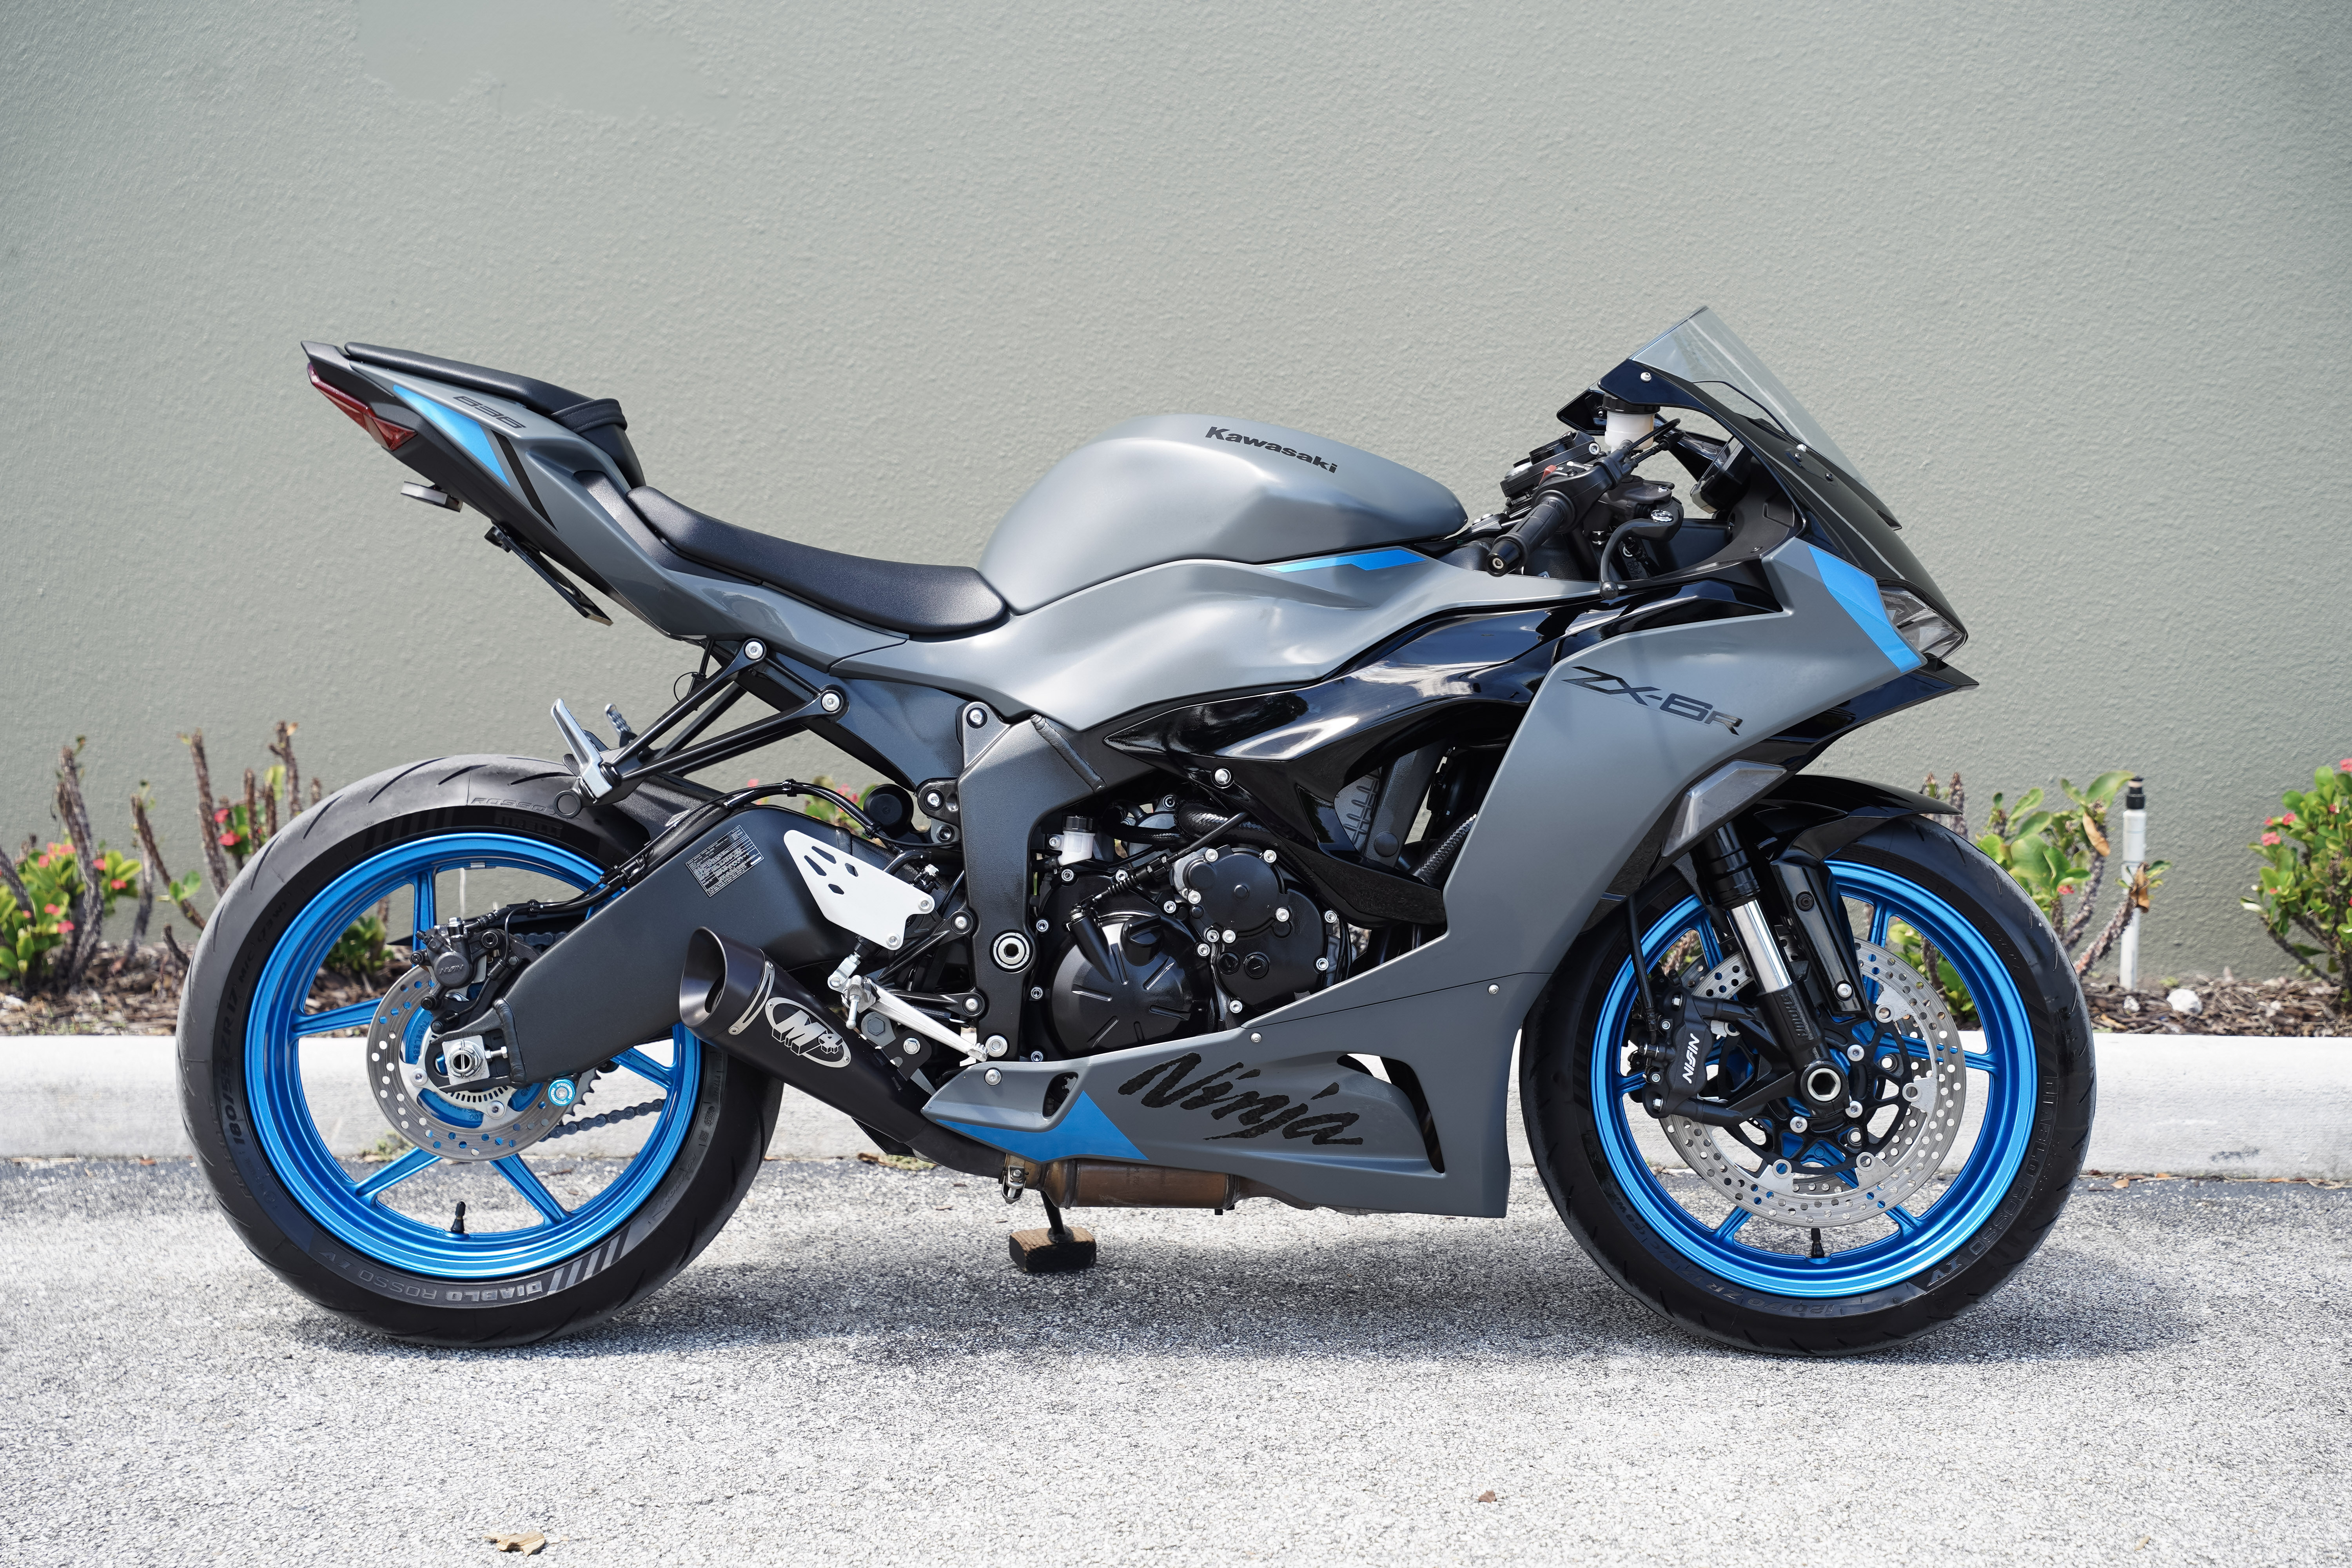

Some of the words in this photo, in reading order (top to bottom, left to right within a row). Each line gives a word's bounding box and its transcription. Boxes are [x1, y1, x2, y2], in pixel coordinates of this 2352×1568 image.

[453, 396, 526, 428] 636
[1205, 426, 1338, 473] Kawasaki
[1561, 666, 1743, 735] ZX-6R
[220, 1016, 234, 1053] ZR
[771, 1009, 844, 1056] M4
[1781, 995, 1808, 1038] SHOWA
[1682, 1033, 1700, 1084] NISSIN
[220, 1060, 246, 1149] 180/55
[704, 1108, 716, 1125] 1925
[1118, 1052, 1364, 1145] Ninja
[2024, 1077, 2058, 1178] DIABLO
[1969, 1182, 2029, 1256] ROSSO
[319, 1248, 352, 1270] IV
[1679, 1265, 1705, 1285] 17
[1926, 1255, 1964, 1287] IV
[357, 1267, 438, 1301] ROSSO
[445, 1279, 544, 1303] DIABLO
[1704, 1279, 1742, 1301] ZR
[1747, 1296, 1837, 1314] 120/70
